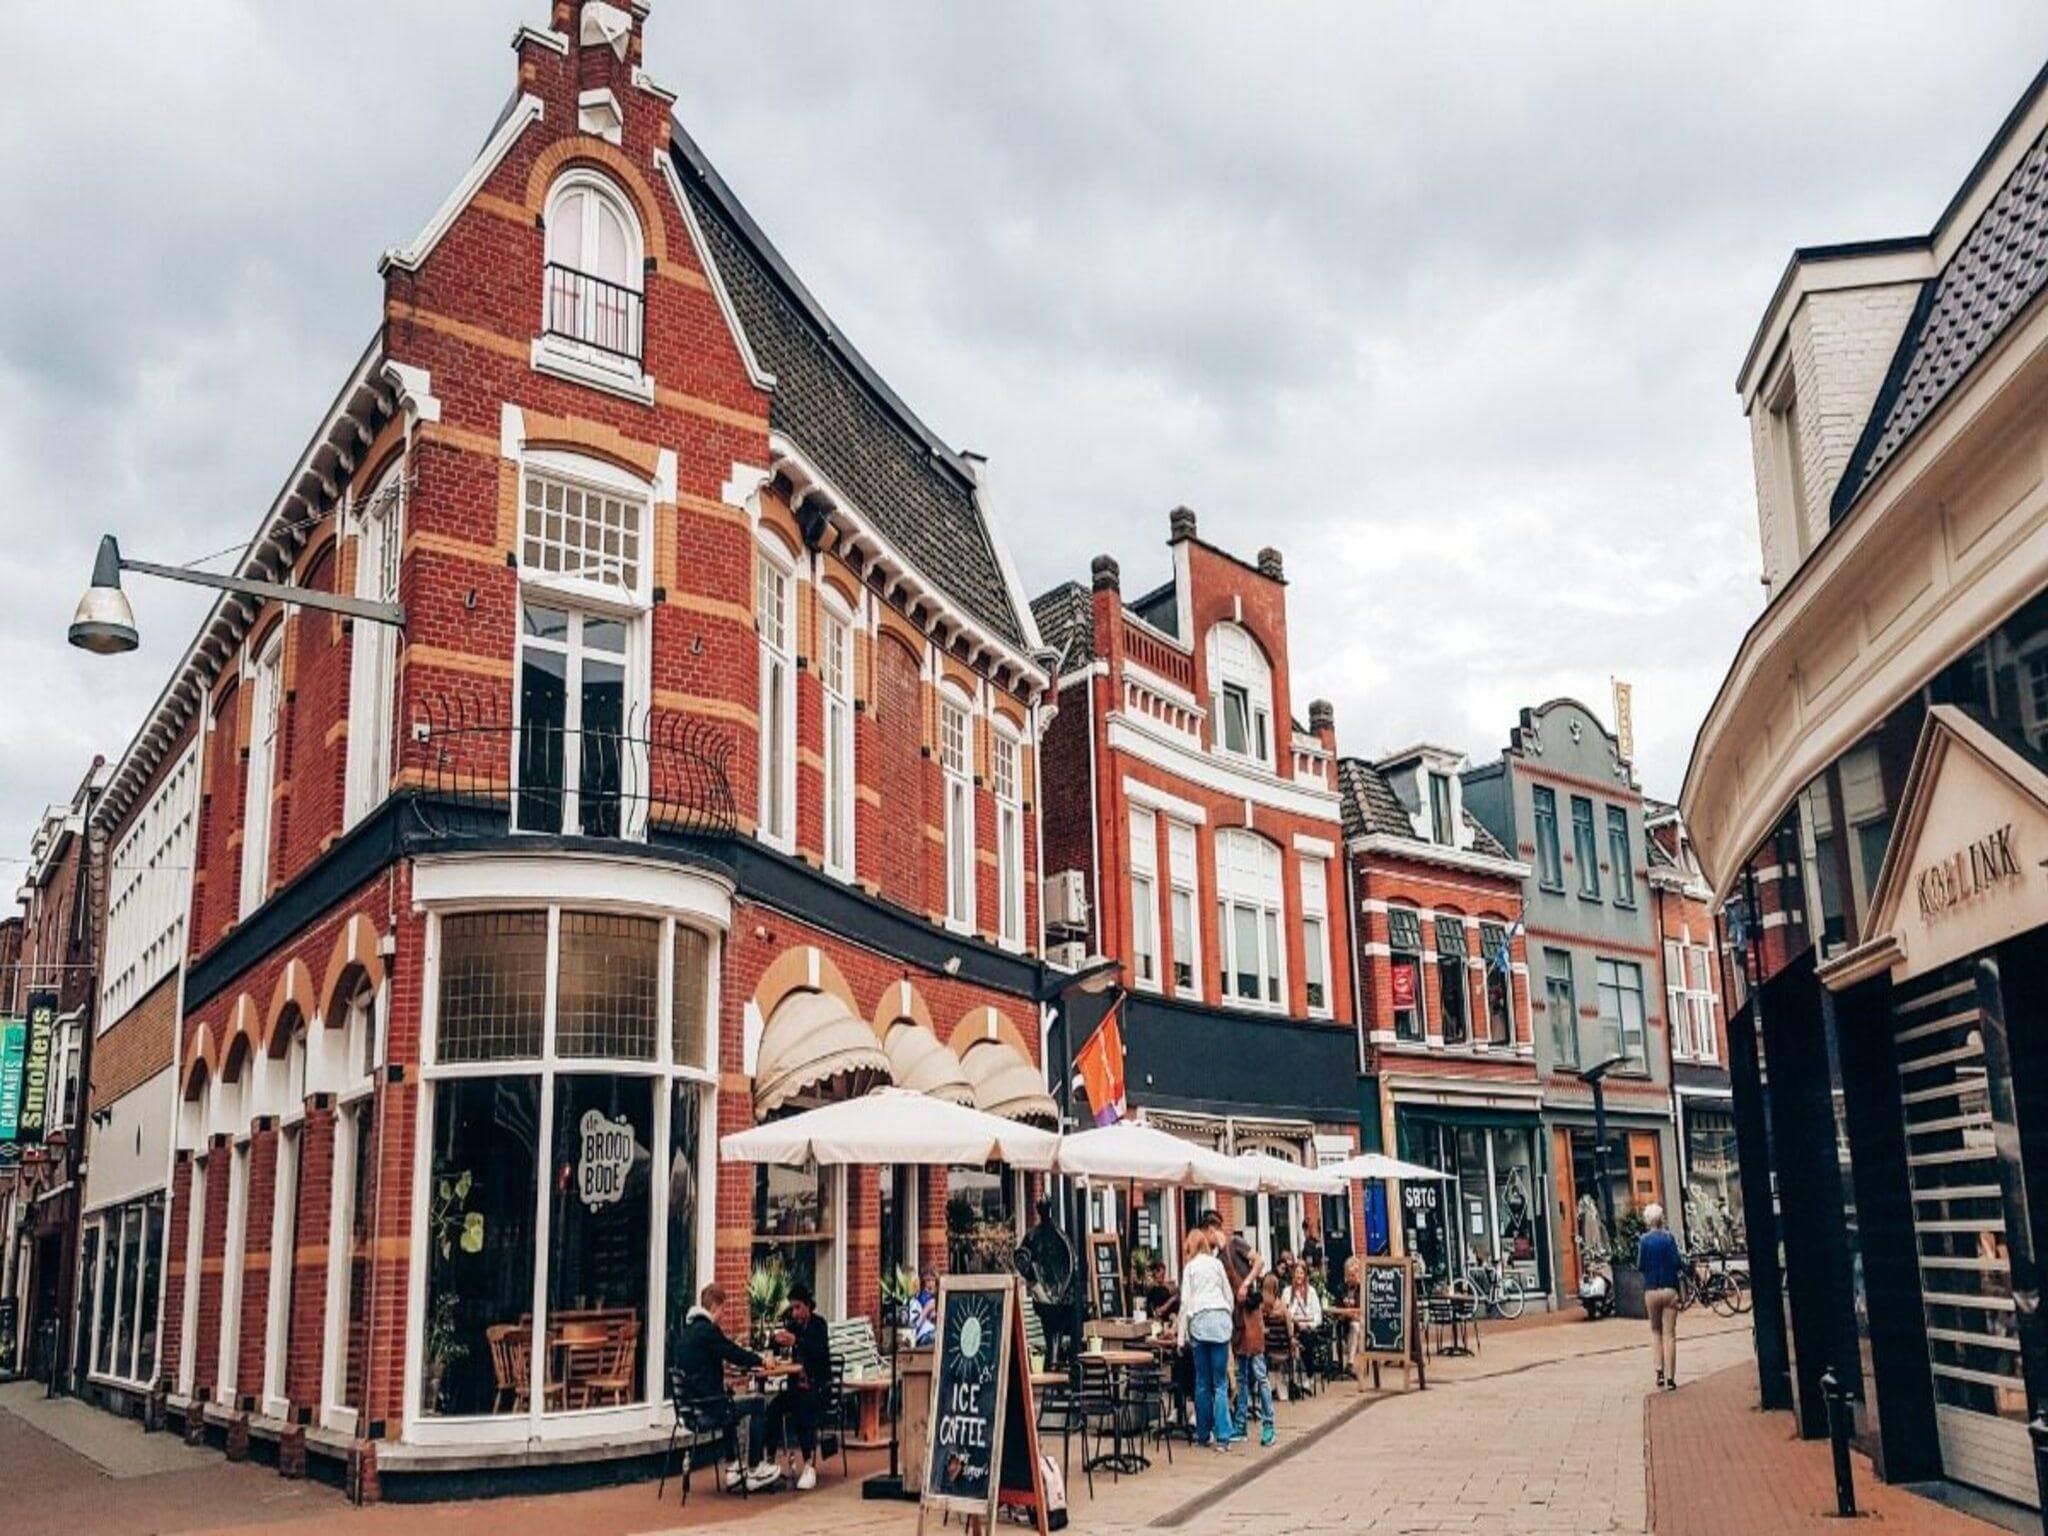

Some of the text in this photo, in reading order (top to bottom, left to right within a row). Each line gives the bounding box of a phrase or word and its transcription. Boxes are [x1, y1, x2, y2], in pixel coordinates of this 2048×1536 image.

[22, 1007, 52, 1130] Smokeys
[1, 1061, 23, 1129] CANNABIS
[586, 1132, 630, 1162] BROOD
[585, 1163, 620, 1194] BODE
[1405, 1187, 1436, 1207] SBTG
[952, 1383, 980, 1413] ICE
[940, 1415, 987, 1447] COFFEE
